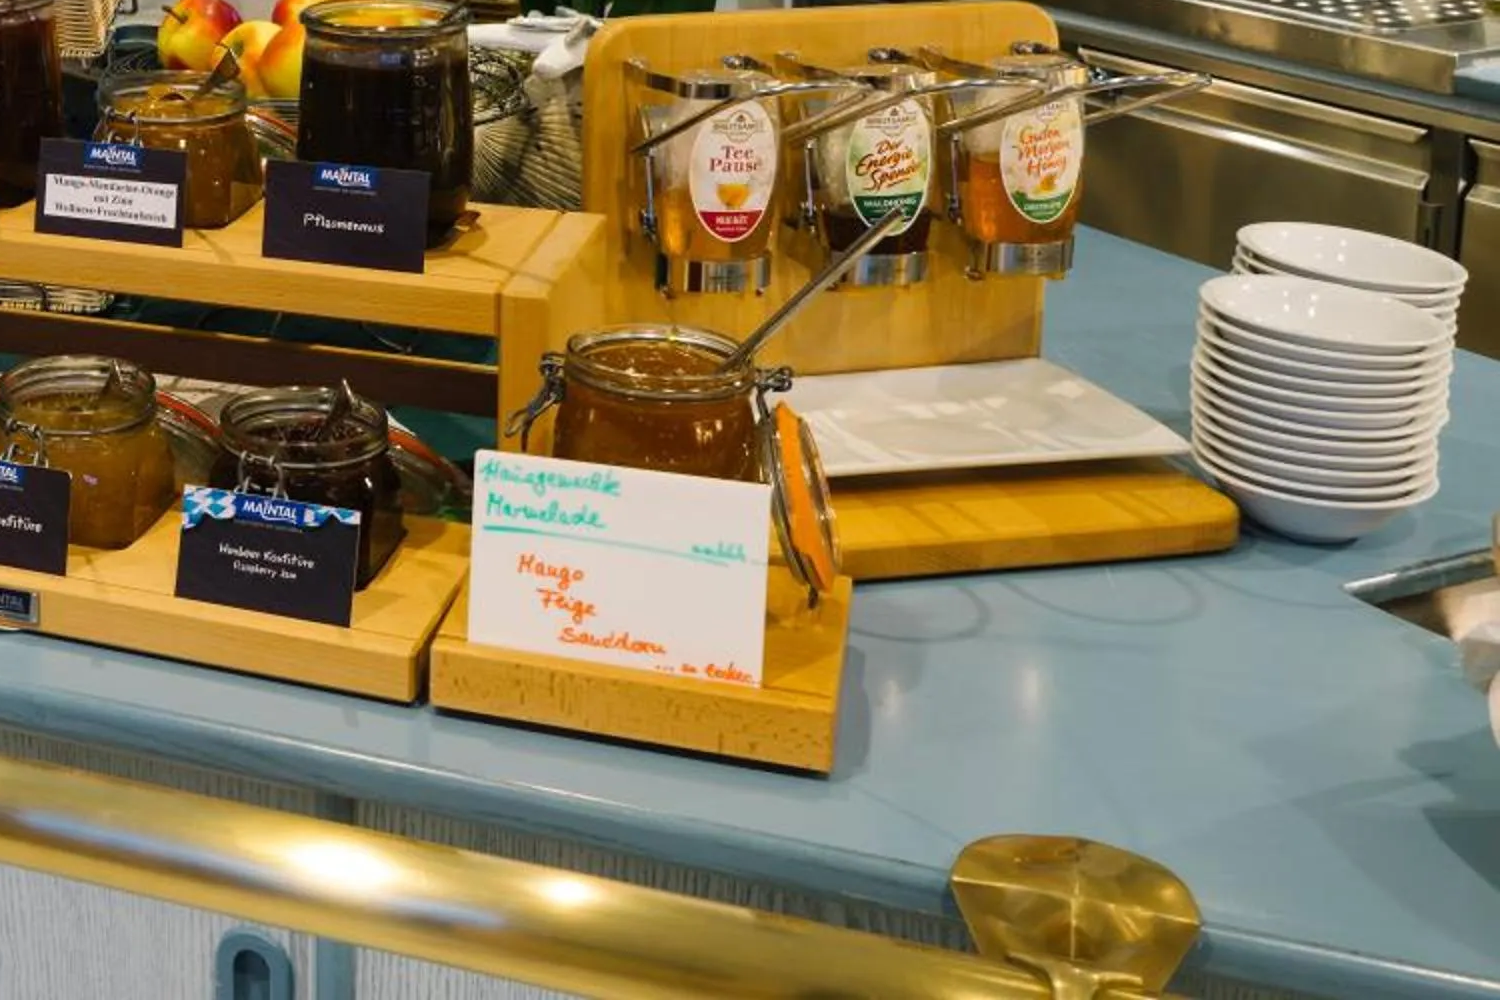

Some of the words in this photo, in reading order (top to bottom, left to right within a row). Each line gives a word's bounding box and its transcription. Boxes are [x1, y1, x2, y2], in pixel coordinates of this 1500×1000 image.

[709, 157, 762, 173] Pause
[721, 145, 756, 160] Tee
[855, 148, 914, 177] Energie
[486, 491, 607, 529] Marmelade
[262, 549, 315, 569] Konfitüre
[517, 553, 585, 590] Mango
[536, 586, 598, 624] Feige
